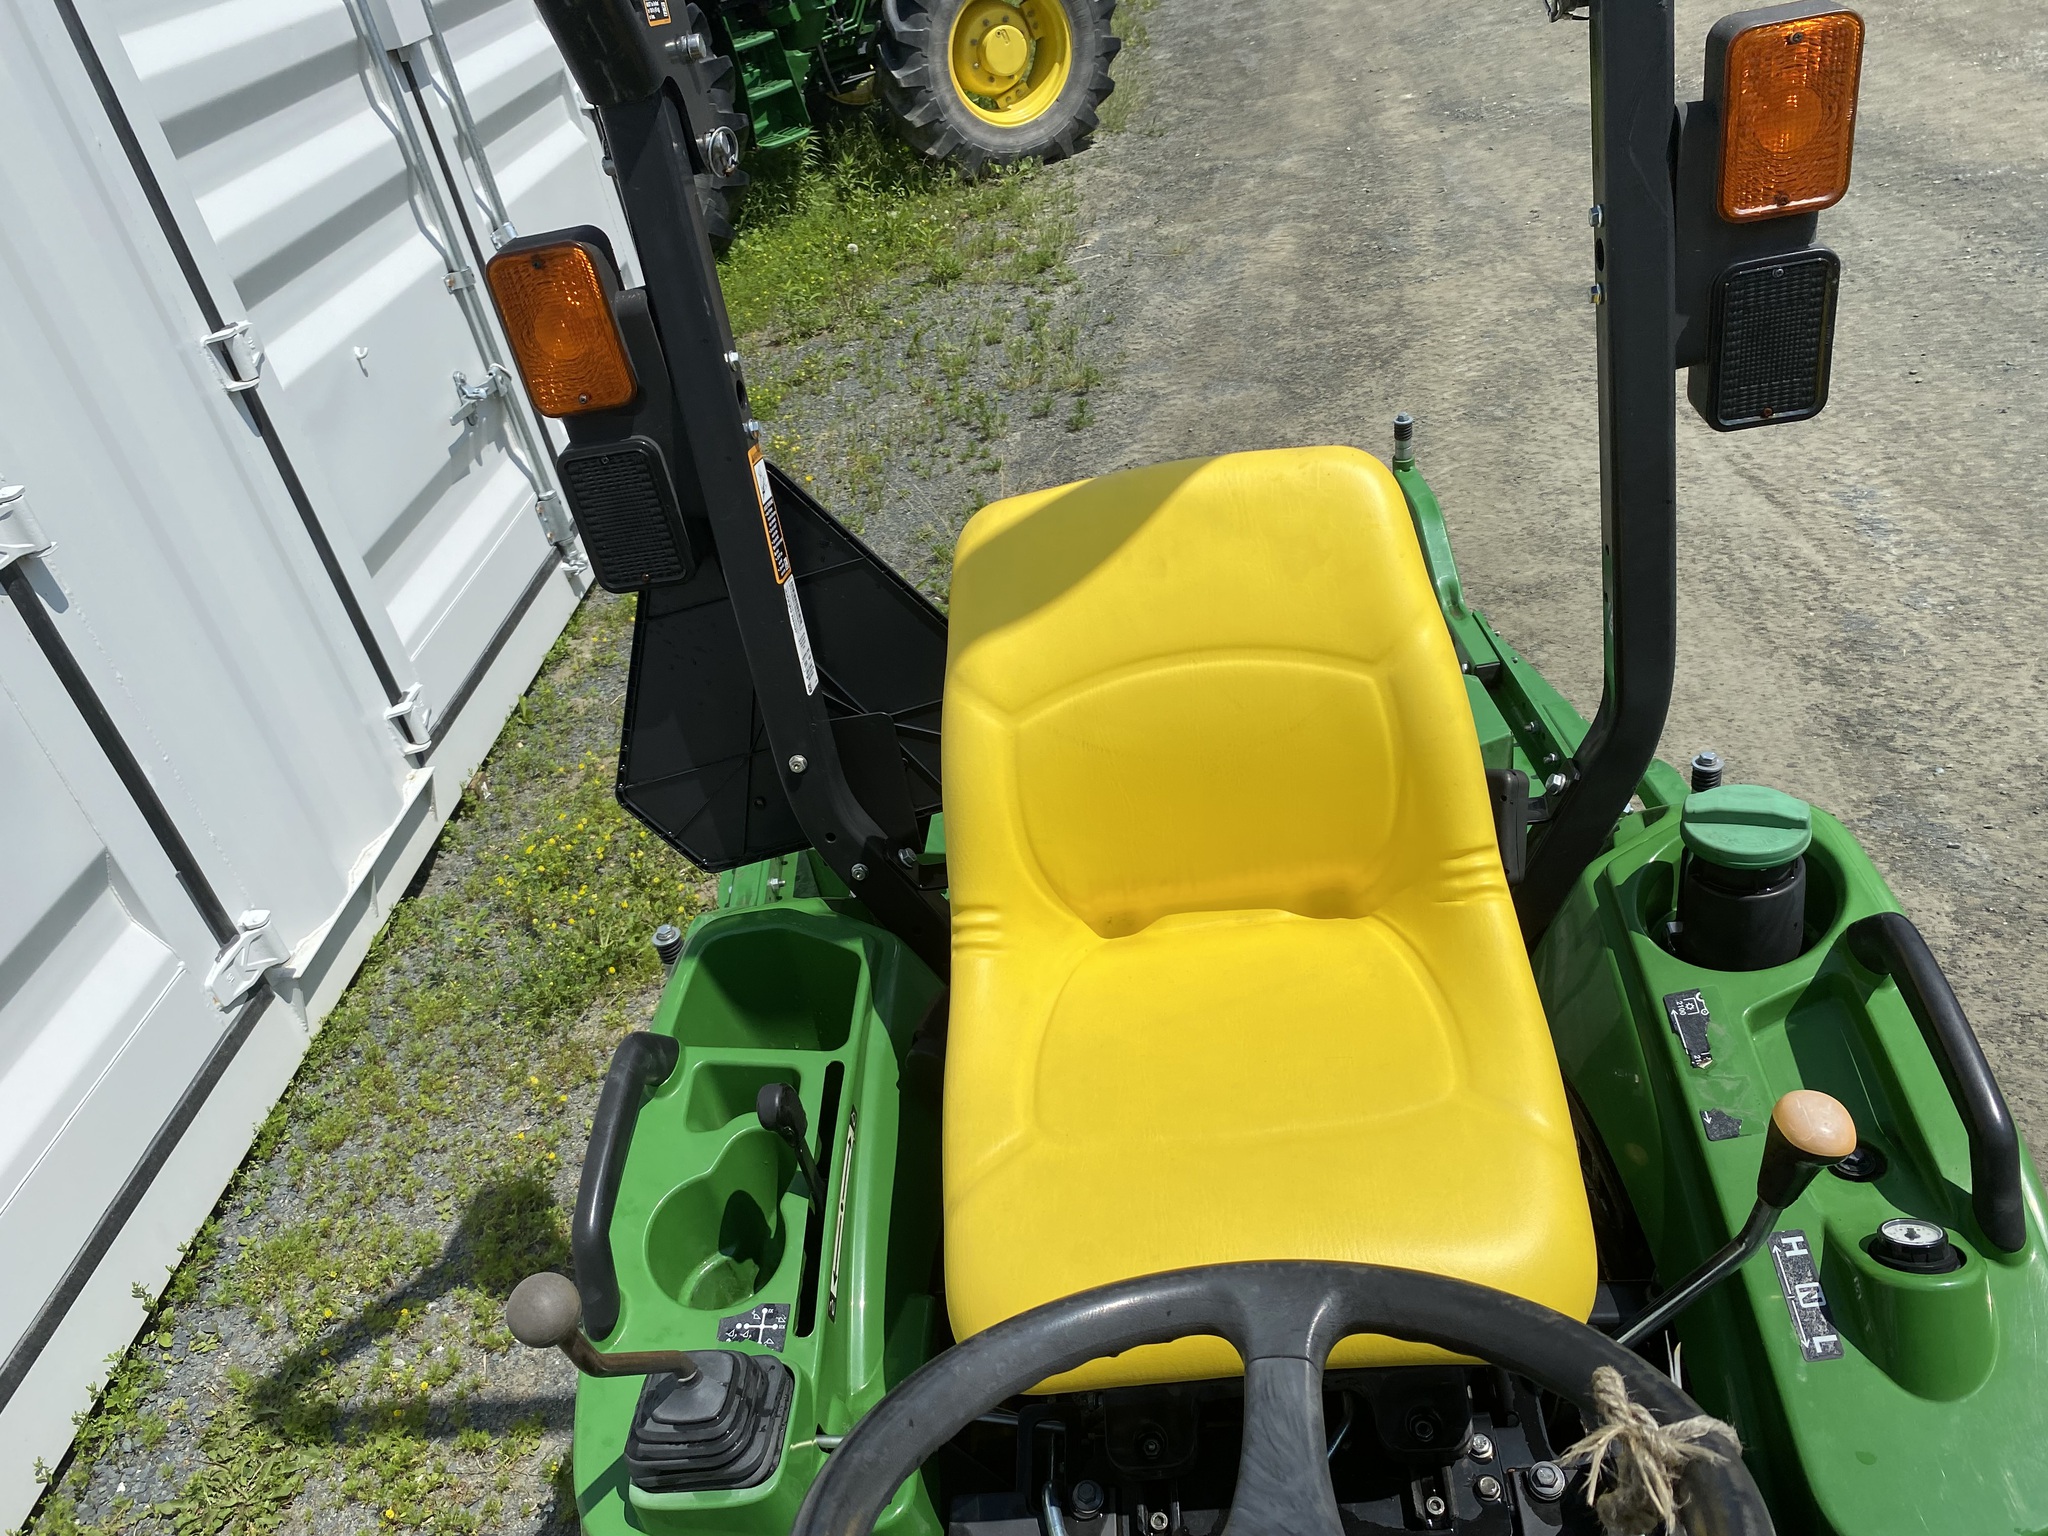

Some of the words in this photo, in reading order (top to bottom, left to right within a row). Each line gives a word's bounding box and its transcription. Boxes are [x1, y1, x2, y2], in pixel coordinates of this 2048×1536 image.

[1676, 1000, 1687, 1015] 2100
[1781, 1235, 1808, 1257] H
[1798, 1286, 1824, 1304] N
[1812, 1334, 1837, 1353] L
